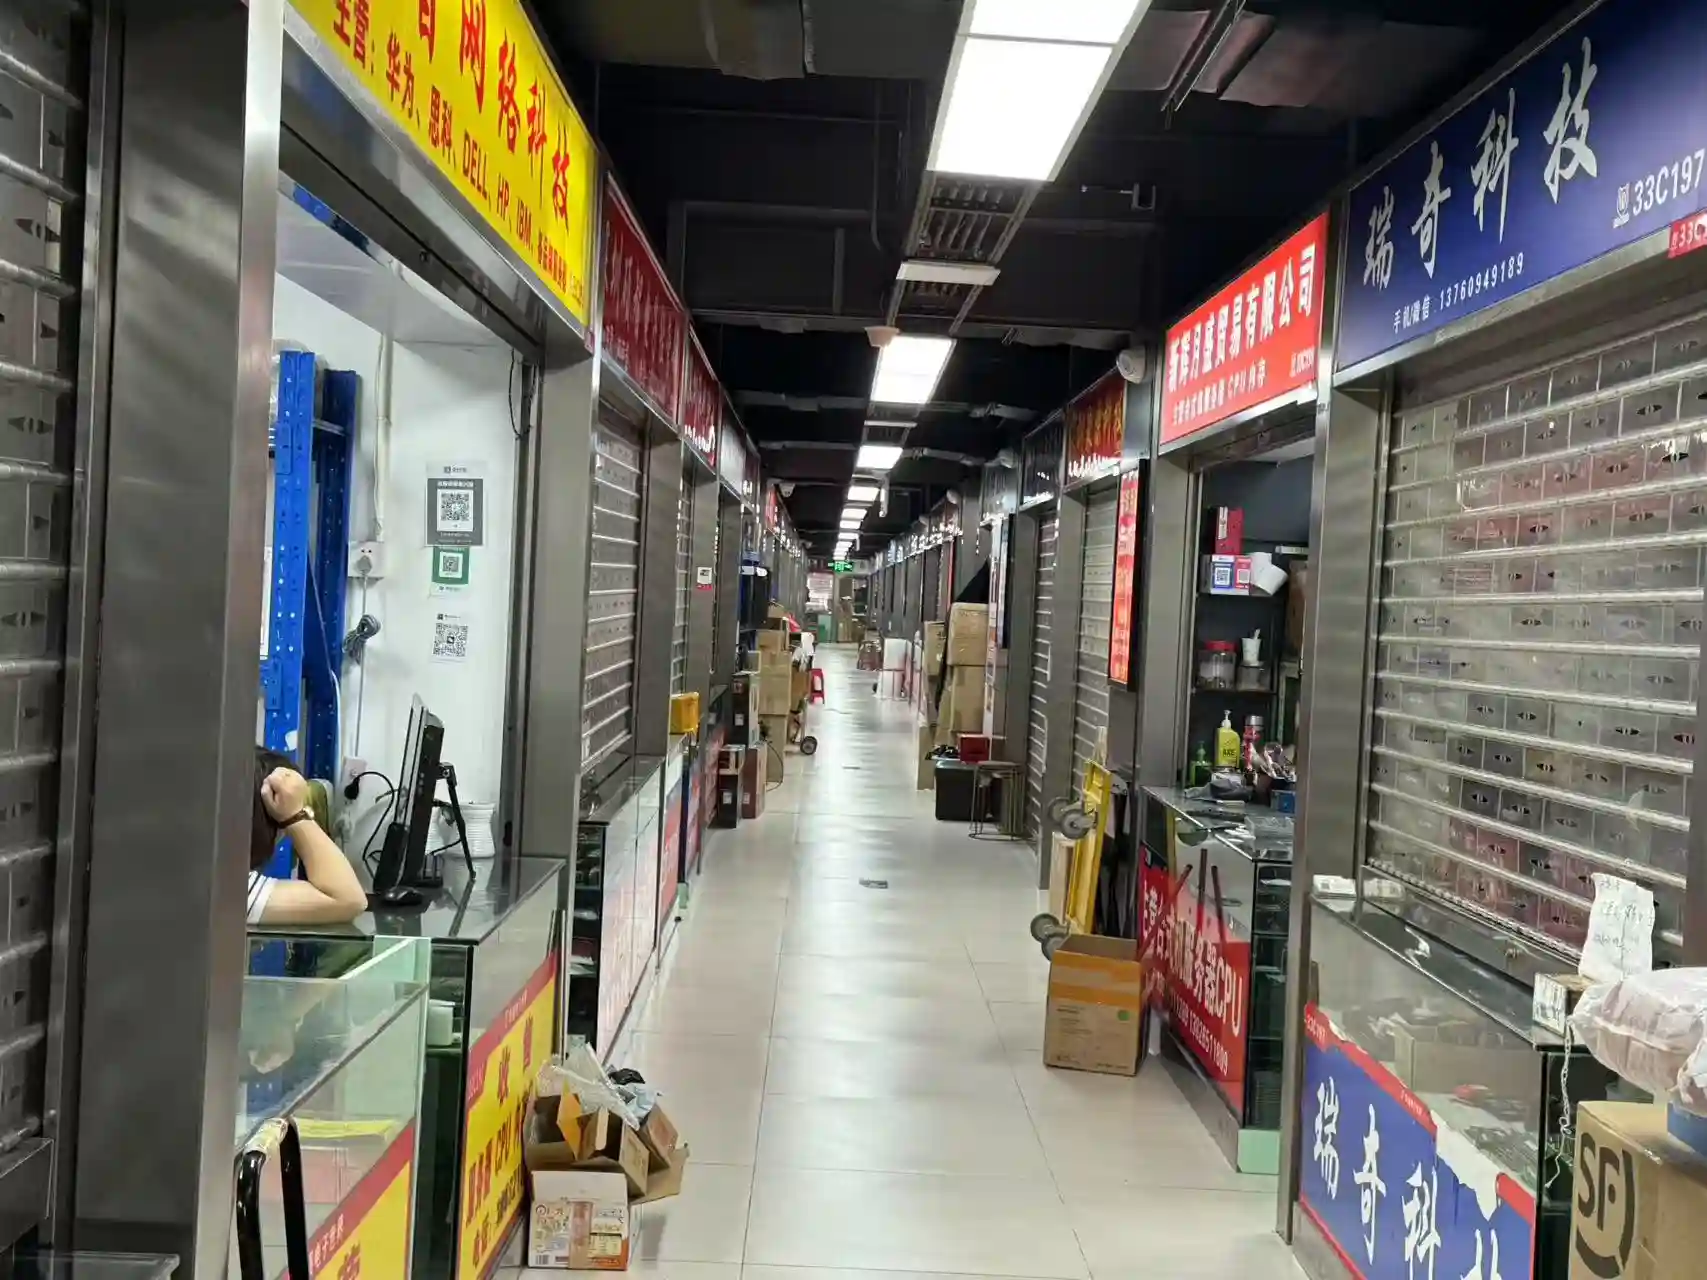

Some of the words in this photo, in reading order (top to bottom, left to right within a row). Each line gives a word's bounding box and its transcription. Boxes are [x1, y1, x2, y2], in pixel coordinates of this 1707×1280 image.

[1363, 36, 1598, 291] 瑞奇科技
[1632, 148, 1706, 216] 33C197
[1577, 1132, 1620, 1232] SF
